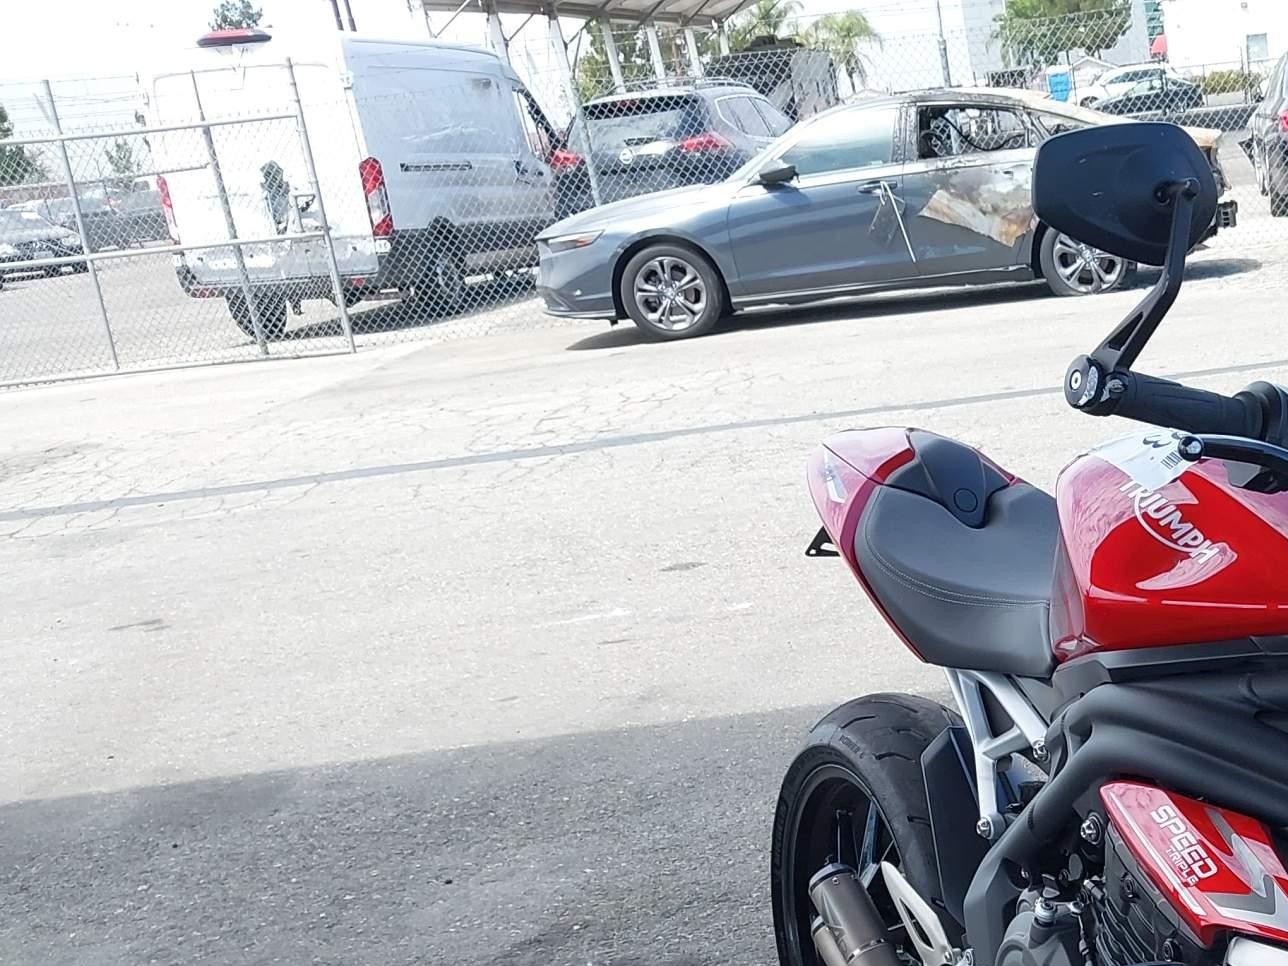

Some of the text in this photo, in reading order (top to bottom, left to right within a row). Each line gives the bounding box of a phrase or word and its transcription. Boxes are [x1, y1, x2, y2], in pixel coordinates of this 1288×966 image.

[1119, 481, 1222, 564] TRIUMPH
[1150, 805, 1218, 879] SPEED
[1165, 846, 1199, 887] TRIPLE
